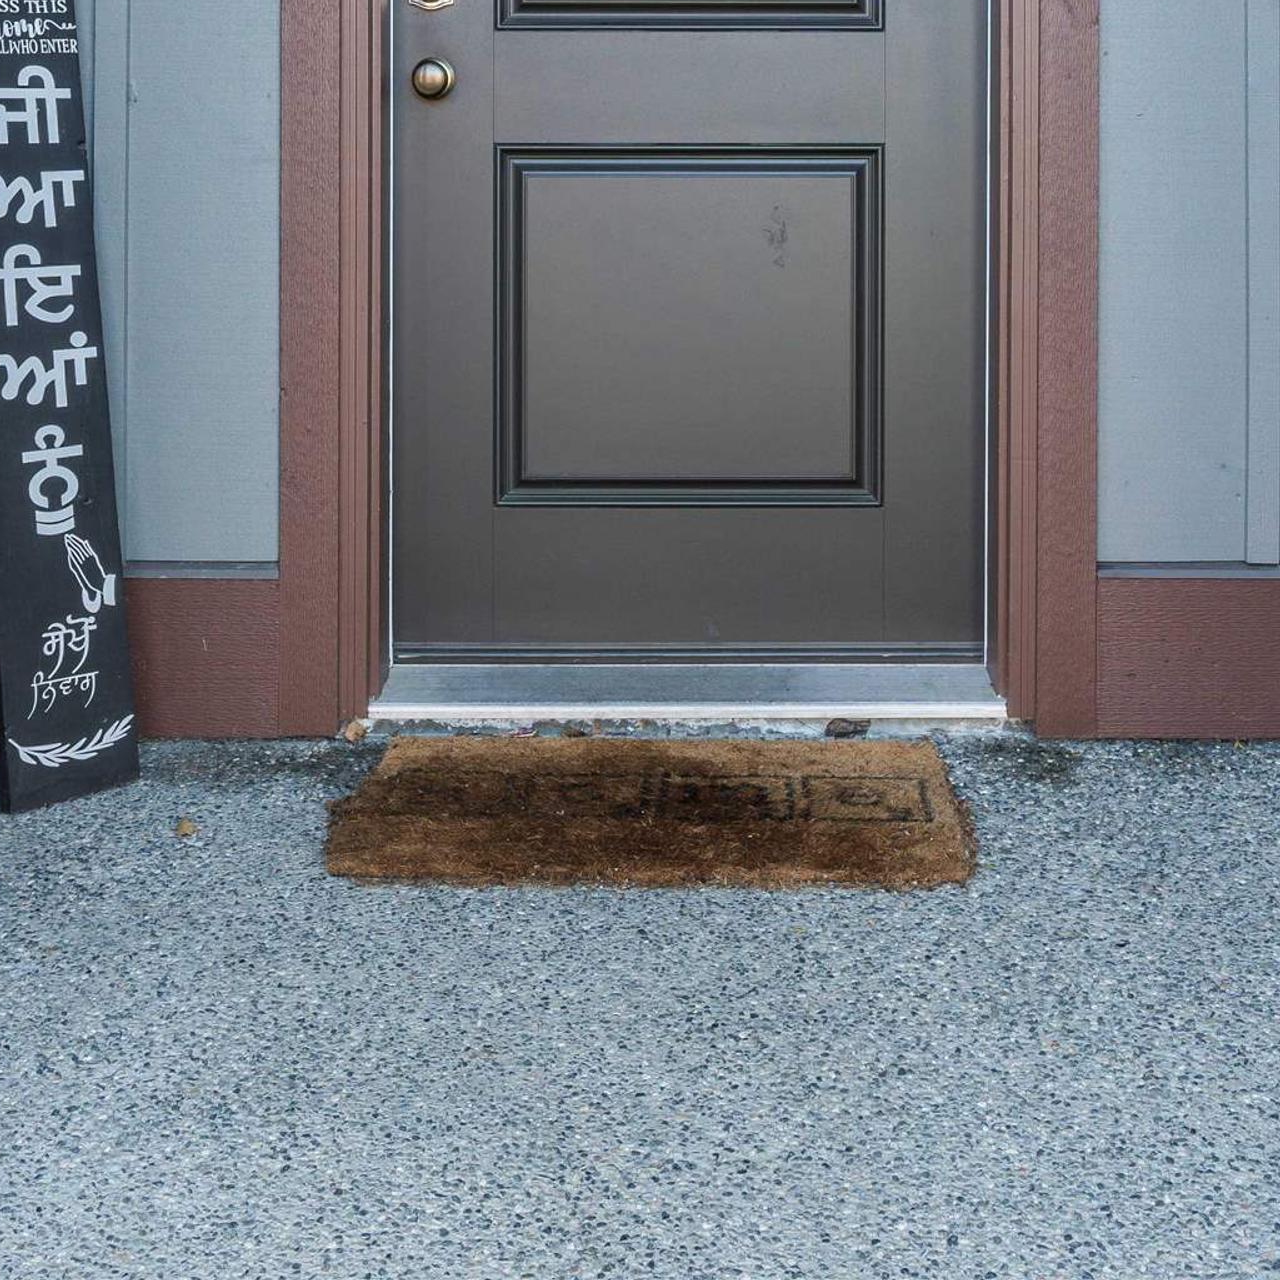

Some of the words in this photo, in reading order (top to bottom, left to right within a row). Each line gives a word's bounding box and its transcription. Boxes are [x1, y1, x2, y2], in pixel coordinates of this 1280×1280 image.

[24, 0, 68, 14] THIS
[9, 38, 39, 55] WHO
[40, 38, 79, 55] ENTER
[22, 424, 84, 536] ਨੂੰ
